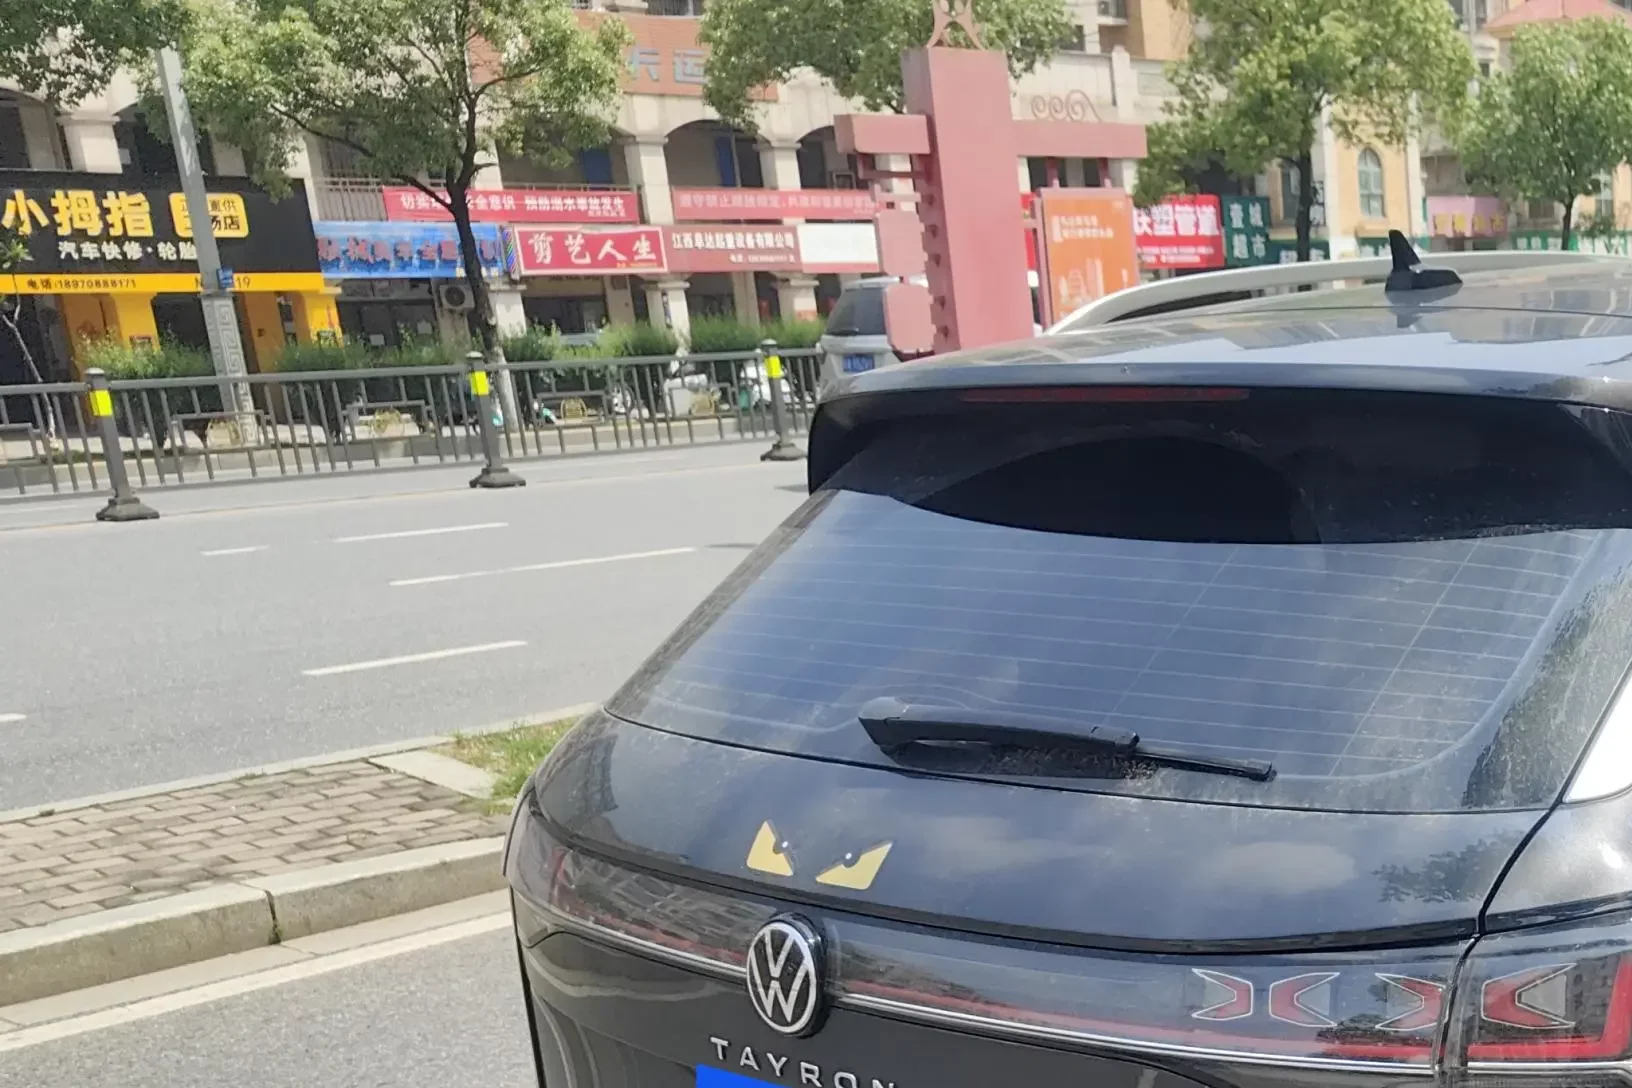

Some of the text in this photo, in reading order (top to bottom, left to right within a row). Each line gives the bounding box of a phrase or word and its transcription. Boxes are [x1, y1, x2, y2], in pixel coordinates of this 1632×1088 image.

[2, 189, 154, 237] 小拇指
[528, 232, 656, 265] 剪艺人生
